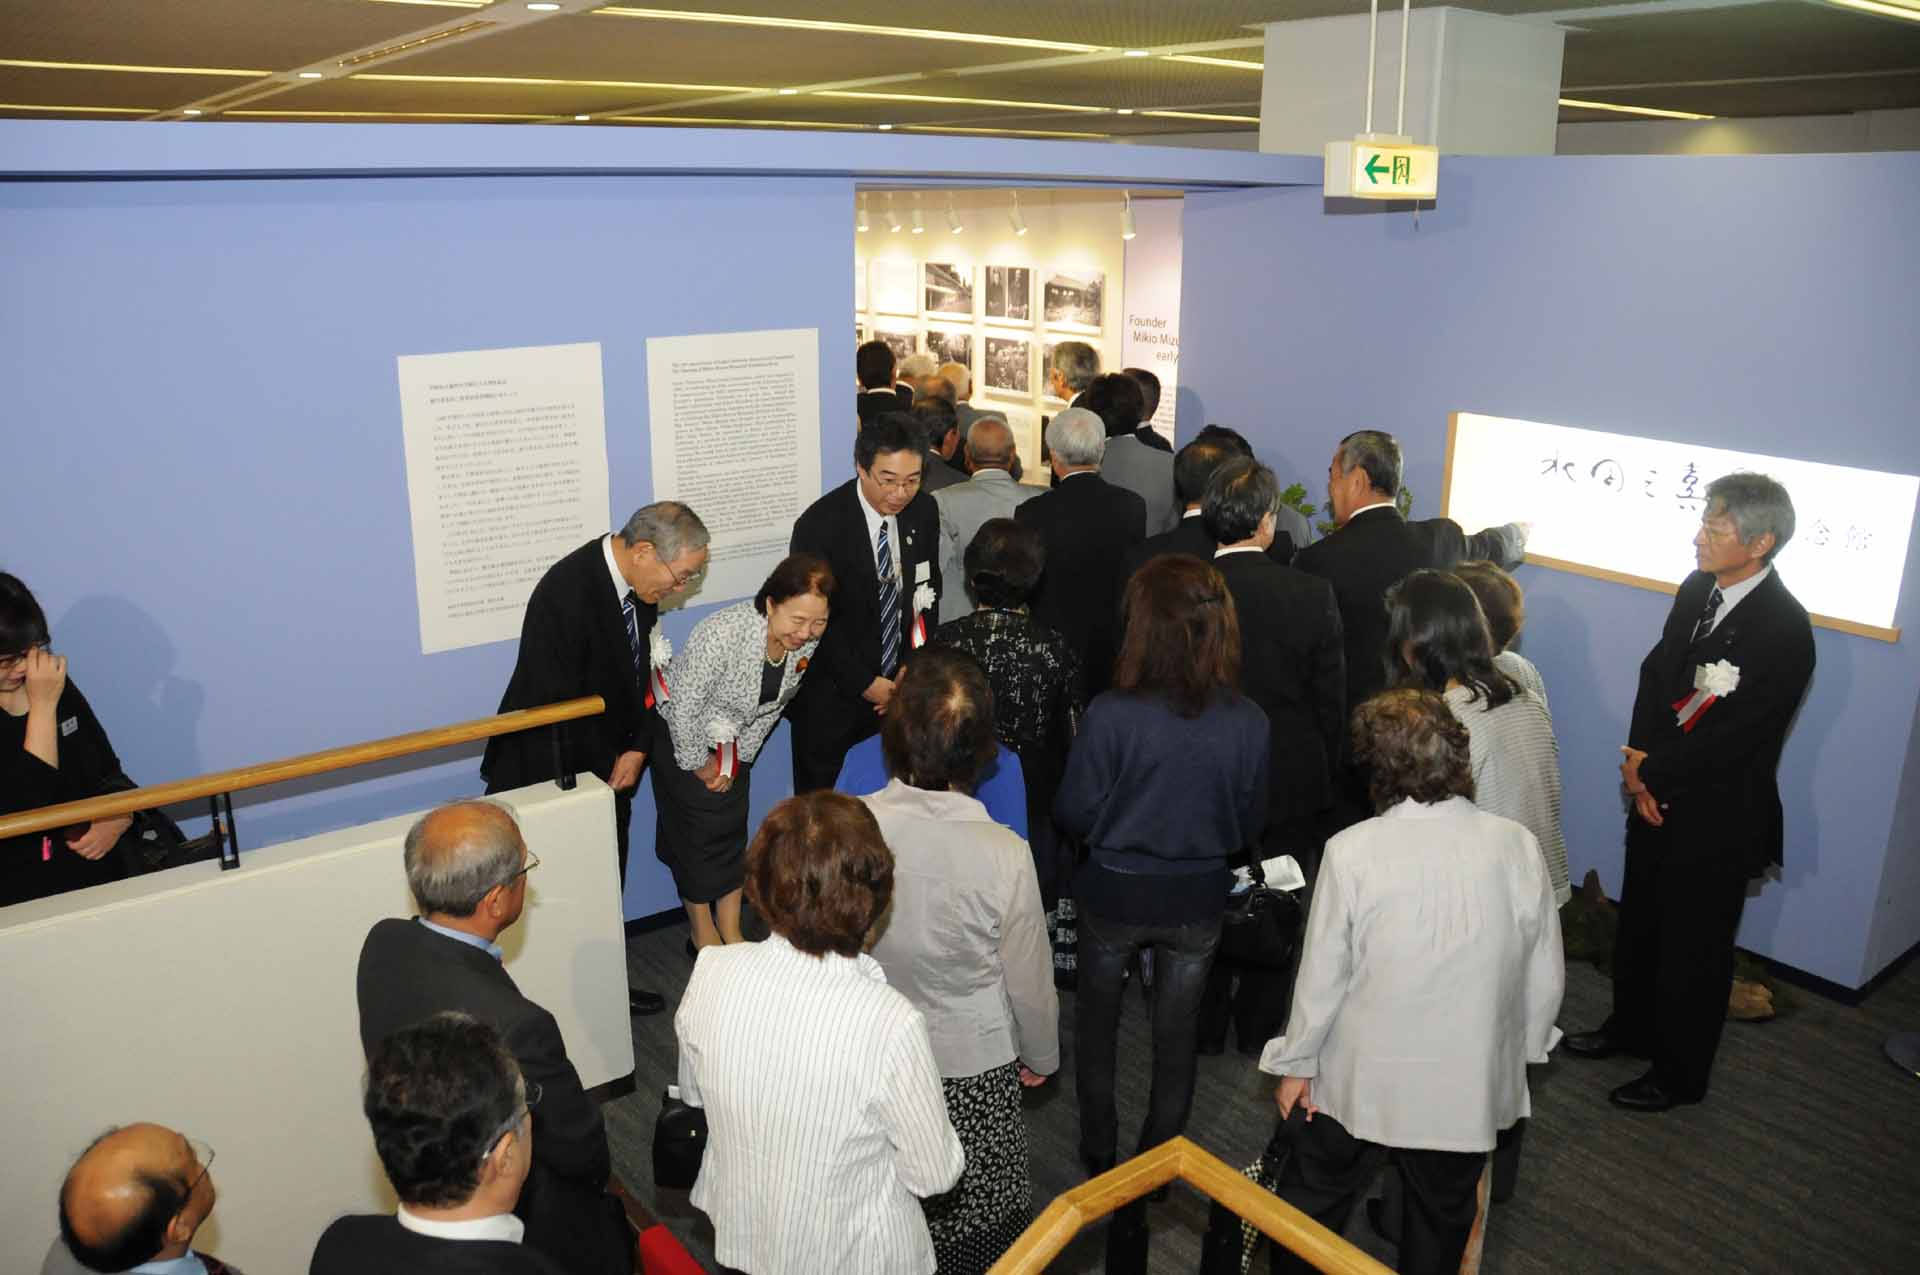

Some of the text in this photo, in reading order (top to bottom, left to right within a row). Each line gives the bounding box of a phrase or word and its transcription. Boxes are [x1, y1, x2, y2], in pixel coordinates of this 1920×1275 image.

[1129, 314, 1167, 328] Founder
[1133, 331, 1157, 344] Mikio
[1156, 351, 1180, 364] early
